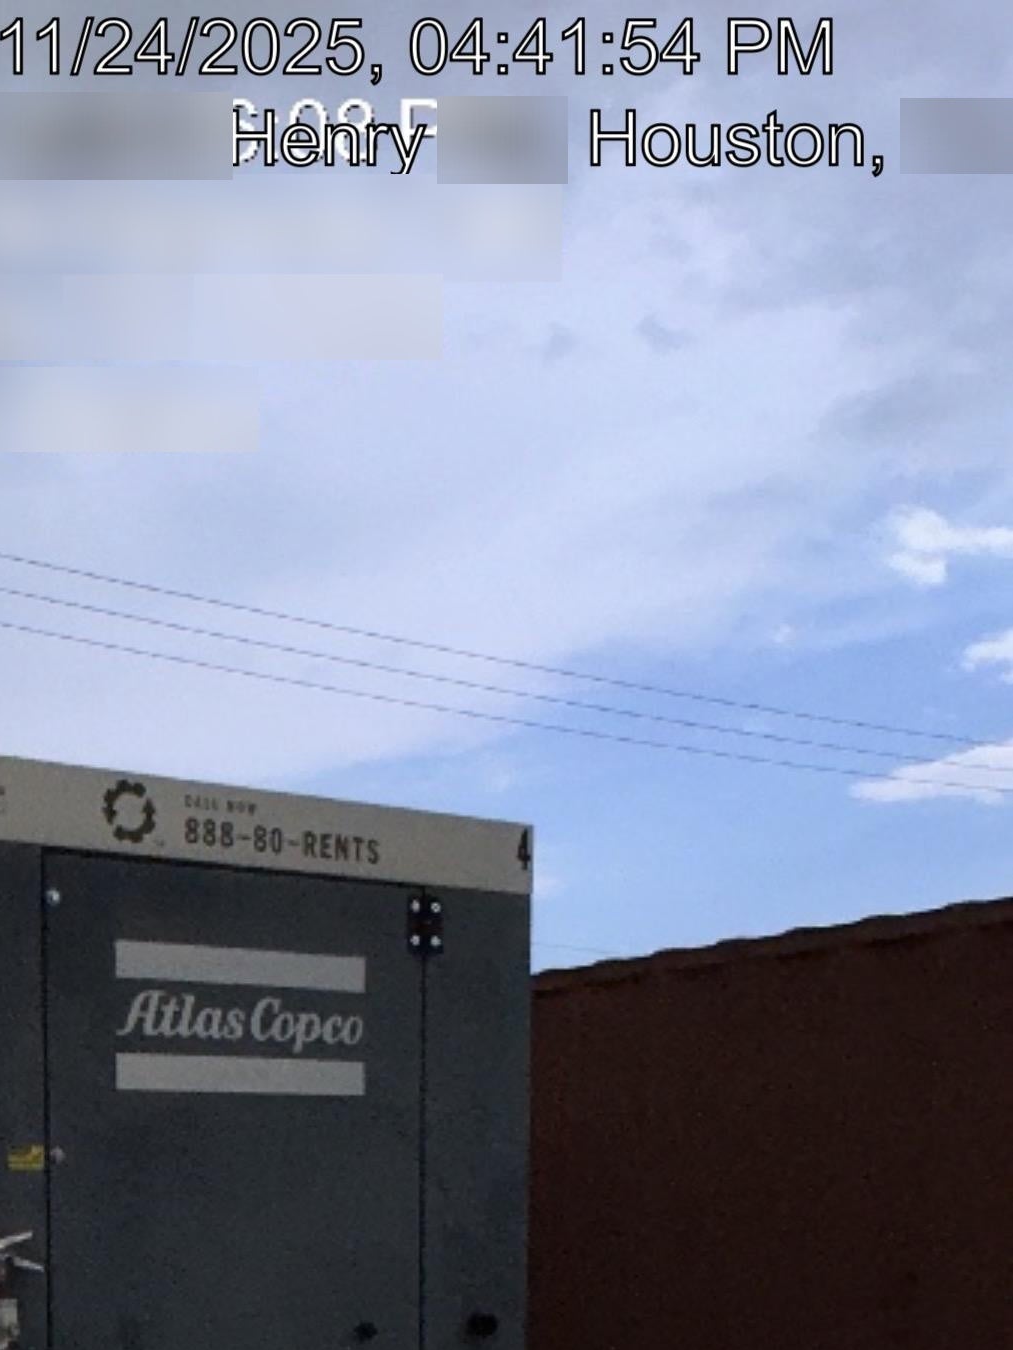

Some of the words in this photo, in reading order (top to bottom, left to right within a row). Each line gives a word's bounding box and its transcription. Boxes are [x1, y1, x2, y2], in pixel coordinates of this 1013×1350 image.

[184, 815, 381, 865] 888-80-RENTS
[116, 988, 245, 1041] Atlas
[250, 994, 364, 1054] Copco
